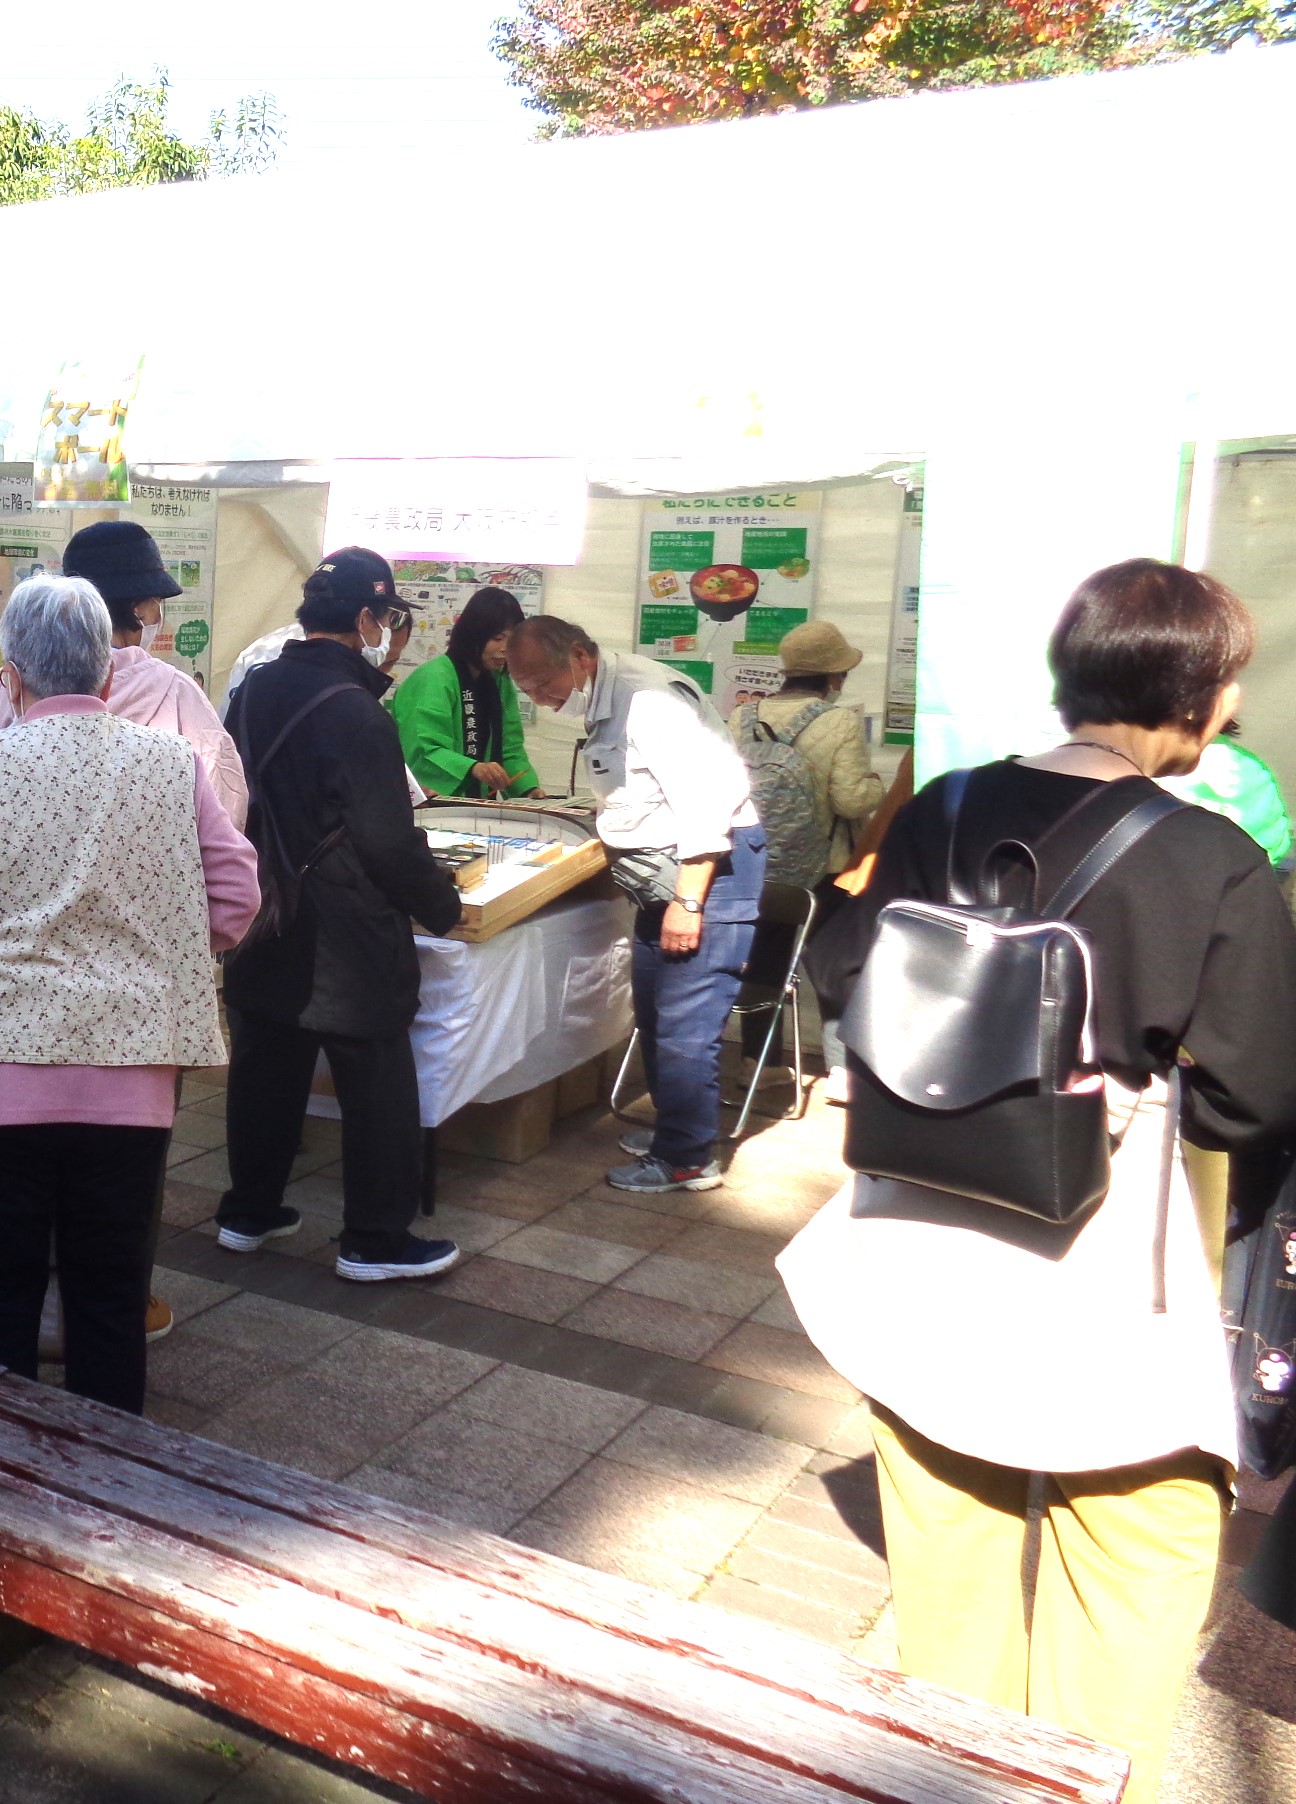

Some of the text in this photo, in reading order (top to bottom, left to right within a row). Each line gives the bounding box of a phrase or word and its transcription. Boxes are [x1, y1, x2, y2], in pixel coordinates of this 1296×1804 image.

[462, 689, 478, 757] 近畿農政局
